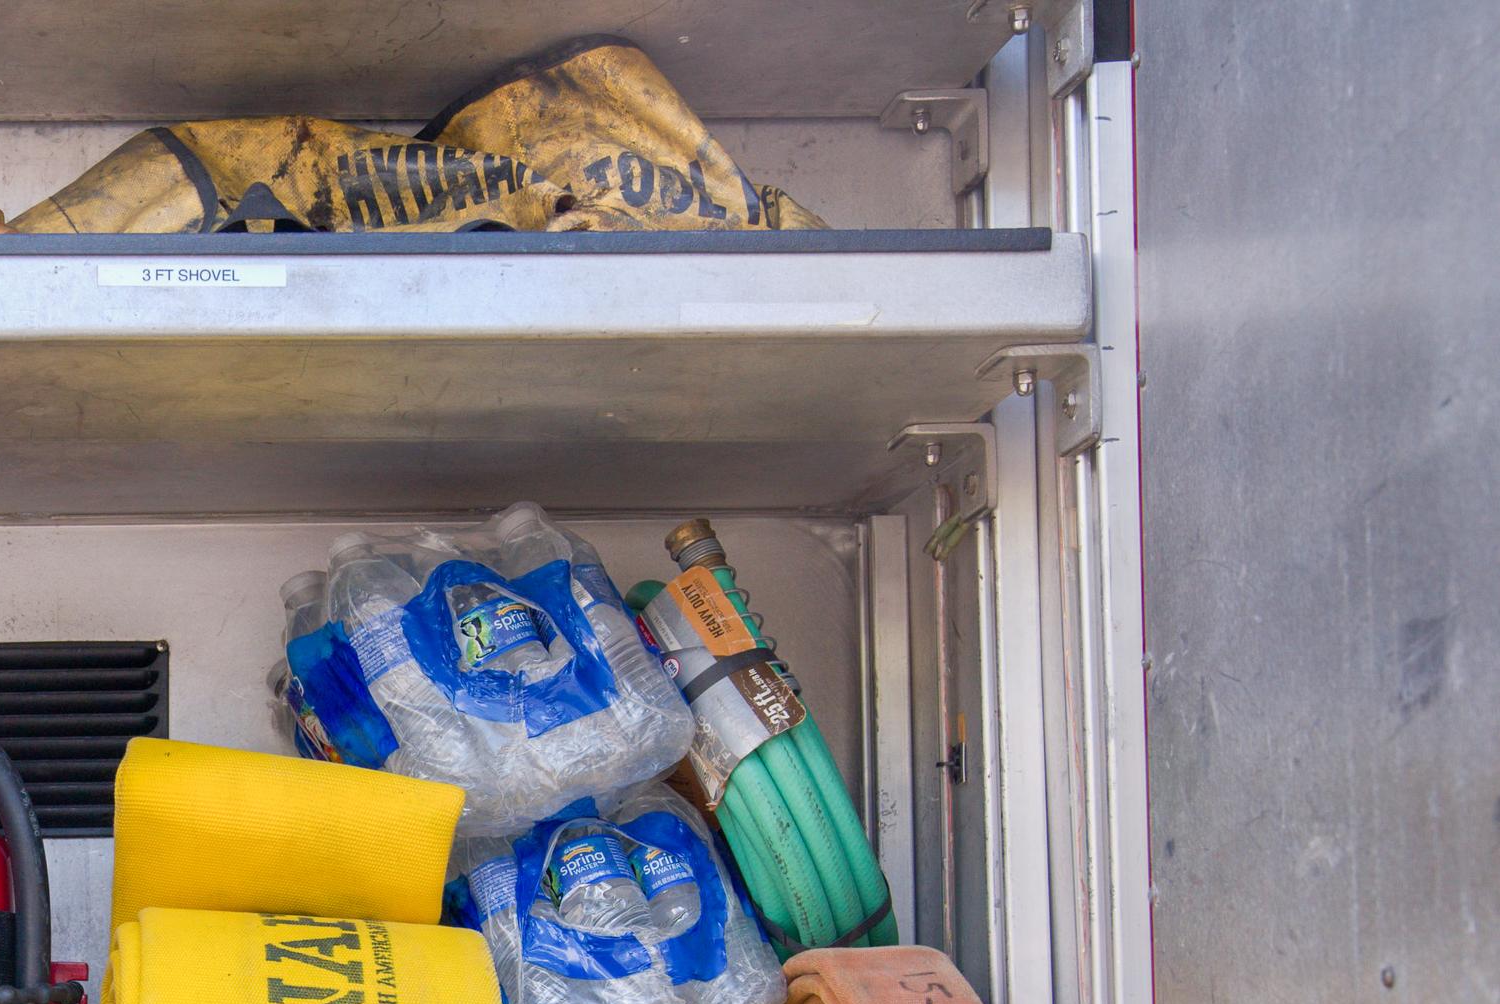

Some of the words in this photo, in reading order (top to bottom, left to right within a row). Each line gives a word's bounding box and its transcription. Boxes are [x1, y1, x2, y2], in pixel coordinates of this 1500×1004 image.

[142, 269, 151, 281] 3
[155, 269, 174, 281] FT
[178, 269, 240, 281] SHOVEL
[681, 584, 705, 609] DUTY
[493, 611, 529, 631] sprin
[698, 609, 725, 639] HEAVY
[763, 702, 790, 725] 25
[560, 851, 606, 877] spring
[573, 863, 598, 876] WATER
[643, 853, 680, 876] sprin
